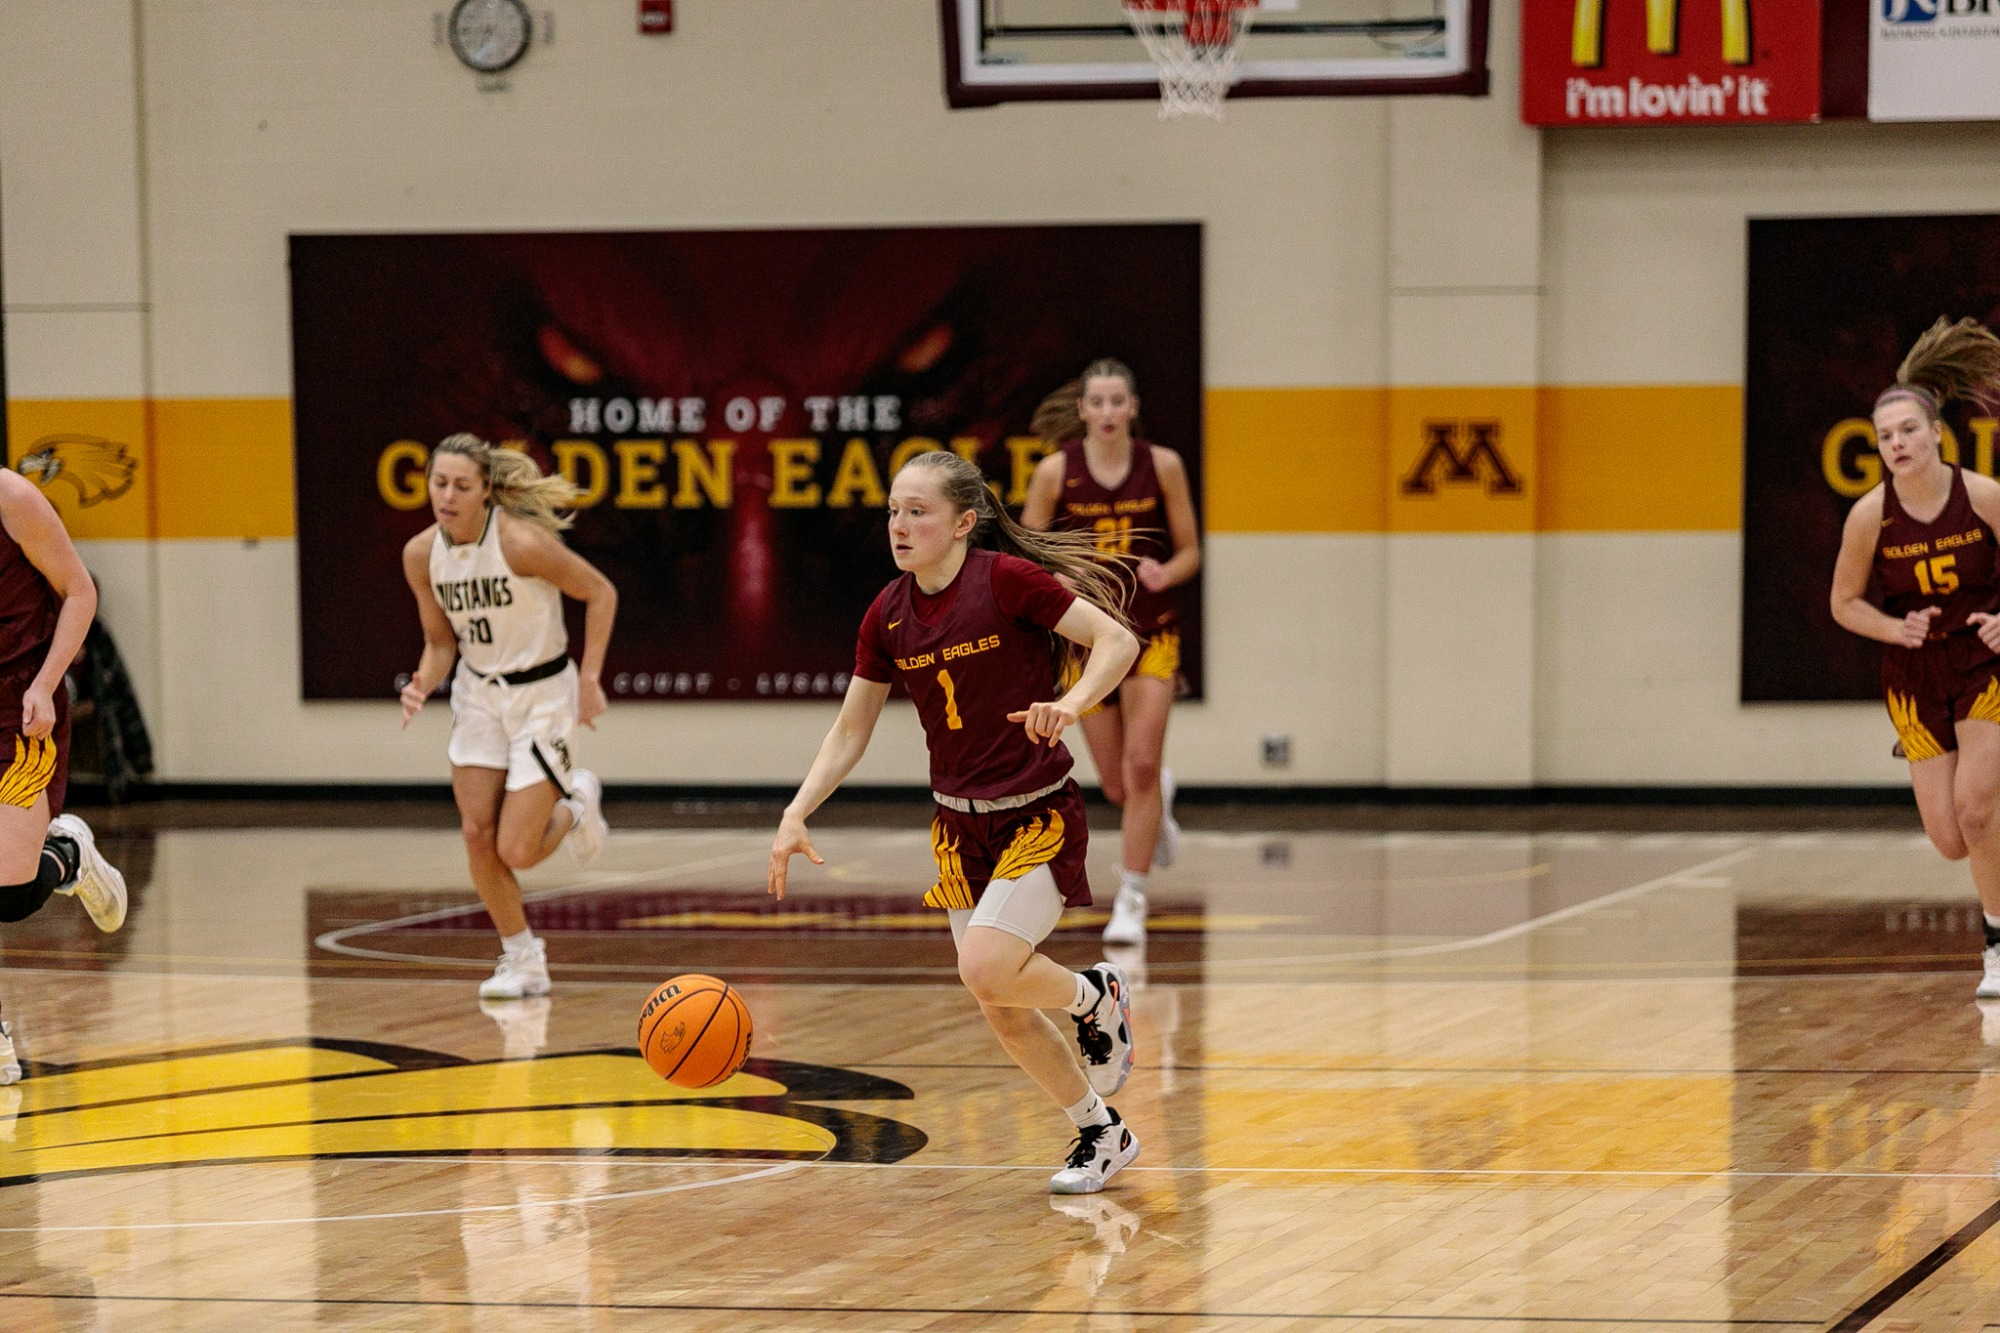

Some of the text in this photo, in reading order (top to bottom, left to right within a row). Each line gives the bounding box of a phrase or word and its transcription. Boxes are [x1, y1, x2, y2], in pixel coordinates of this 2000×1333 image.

[1565, 75, 1768, 117] i'm lovin' it
[568, 394, 901, 433] HOME OF THE
[377, 439, 736, 510] GDEN
[1883, 529, 1982, 559] GOLDEN EAGLES
[1914, 553, 1960, 596] 15
[942, 634, 1000, 661] EAGLES
[937, 669, 963, 730] 1
